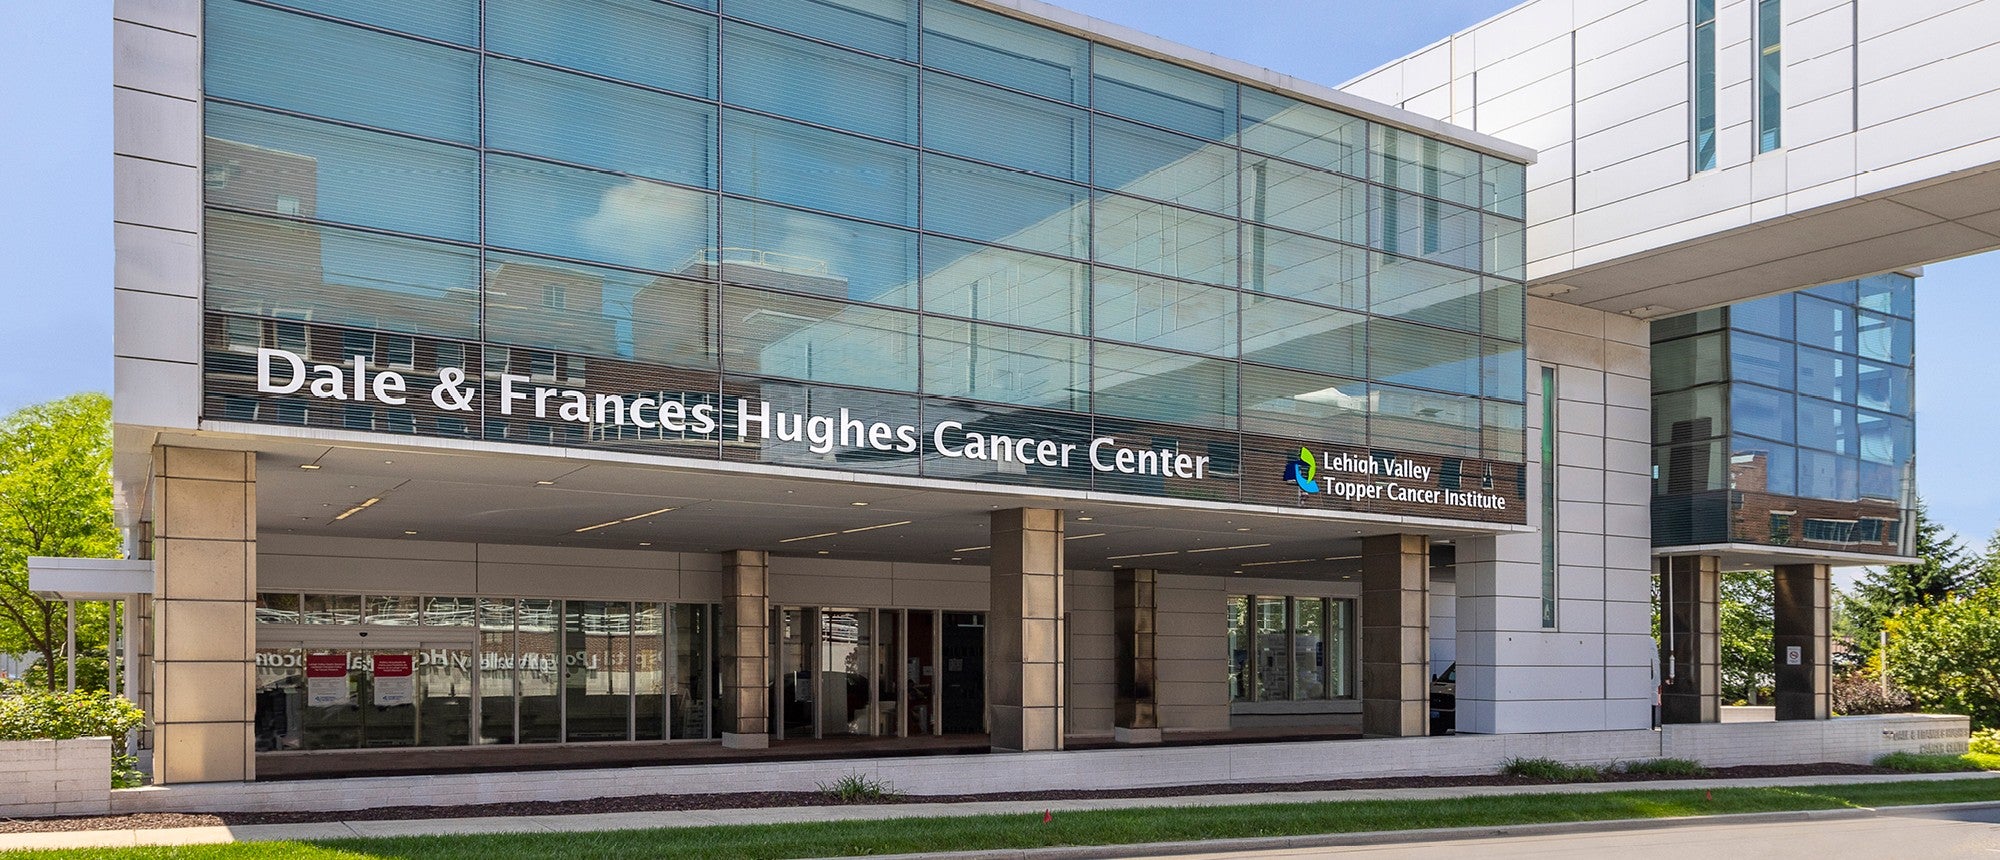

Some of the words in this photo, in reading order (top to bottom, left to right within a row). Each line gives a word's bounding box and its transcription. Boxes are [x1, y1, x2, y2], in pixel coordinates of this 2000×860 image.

[257, 347, 406, 405] Dale
[431, 366, 476, 412] &
[501, 373, 719, 435] Frances
[737, 398, 918, 455] Hughes
[933, 420, 1077, 468] Cancer
[1089, 436, 1210, 480] Center
[1323, 451, 1379, 476] Lehigh
[1383, 458, 1432, 483] Valley
[1322, 476, 1384, 502] Topper
[1387, 482, 1441, 504] Cancer
[1445, 487, 1507, 510] Institute
